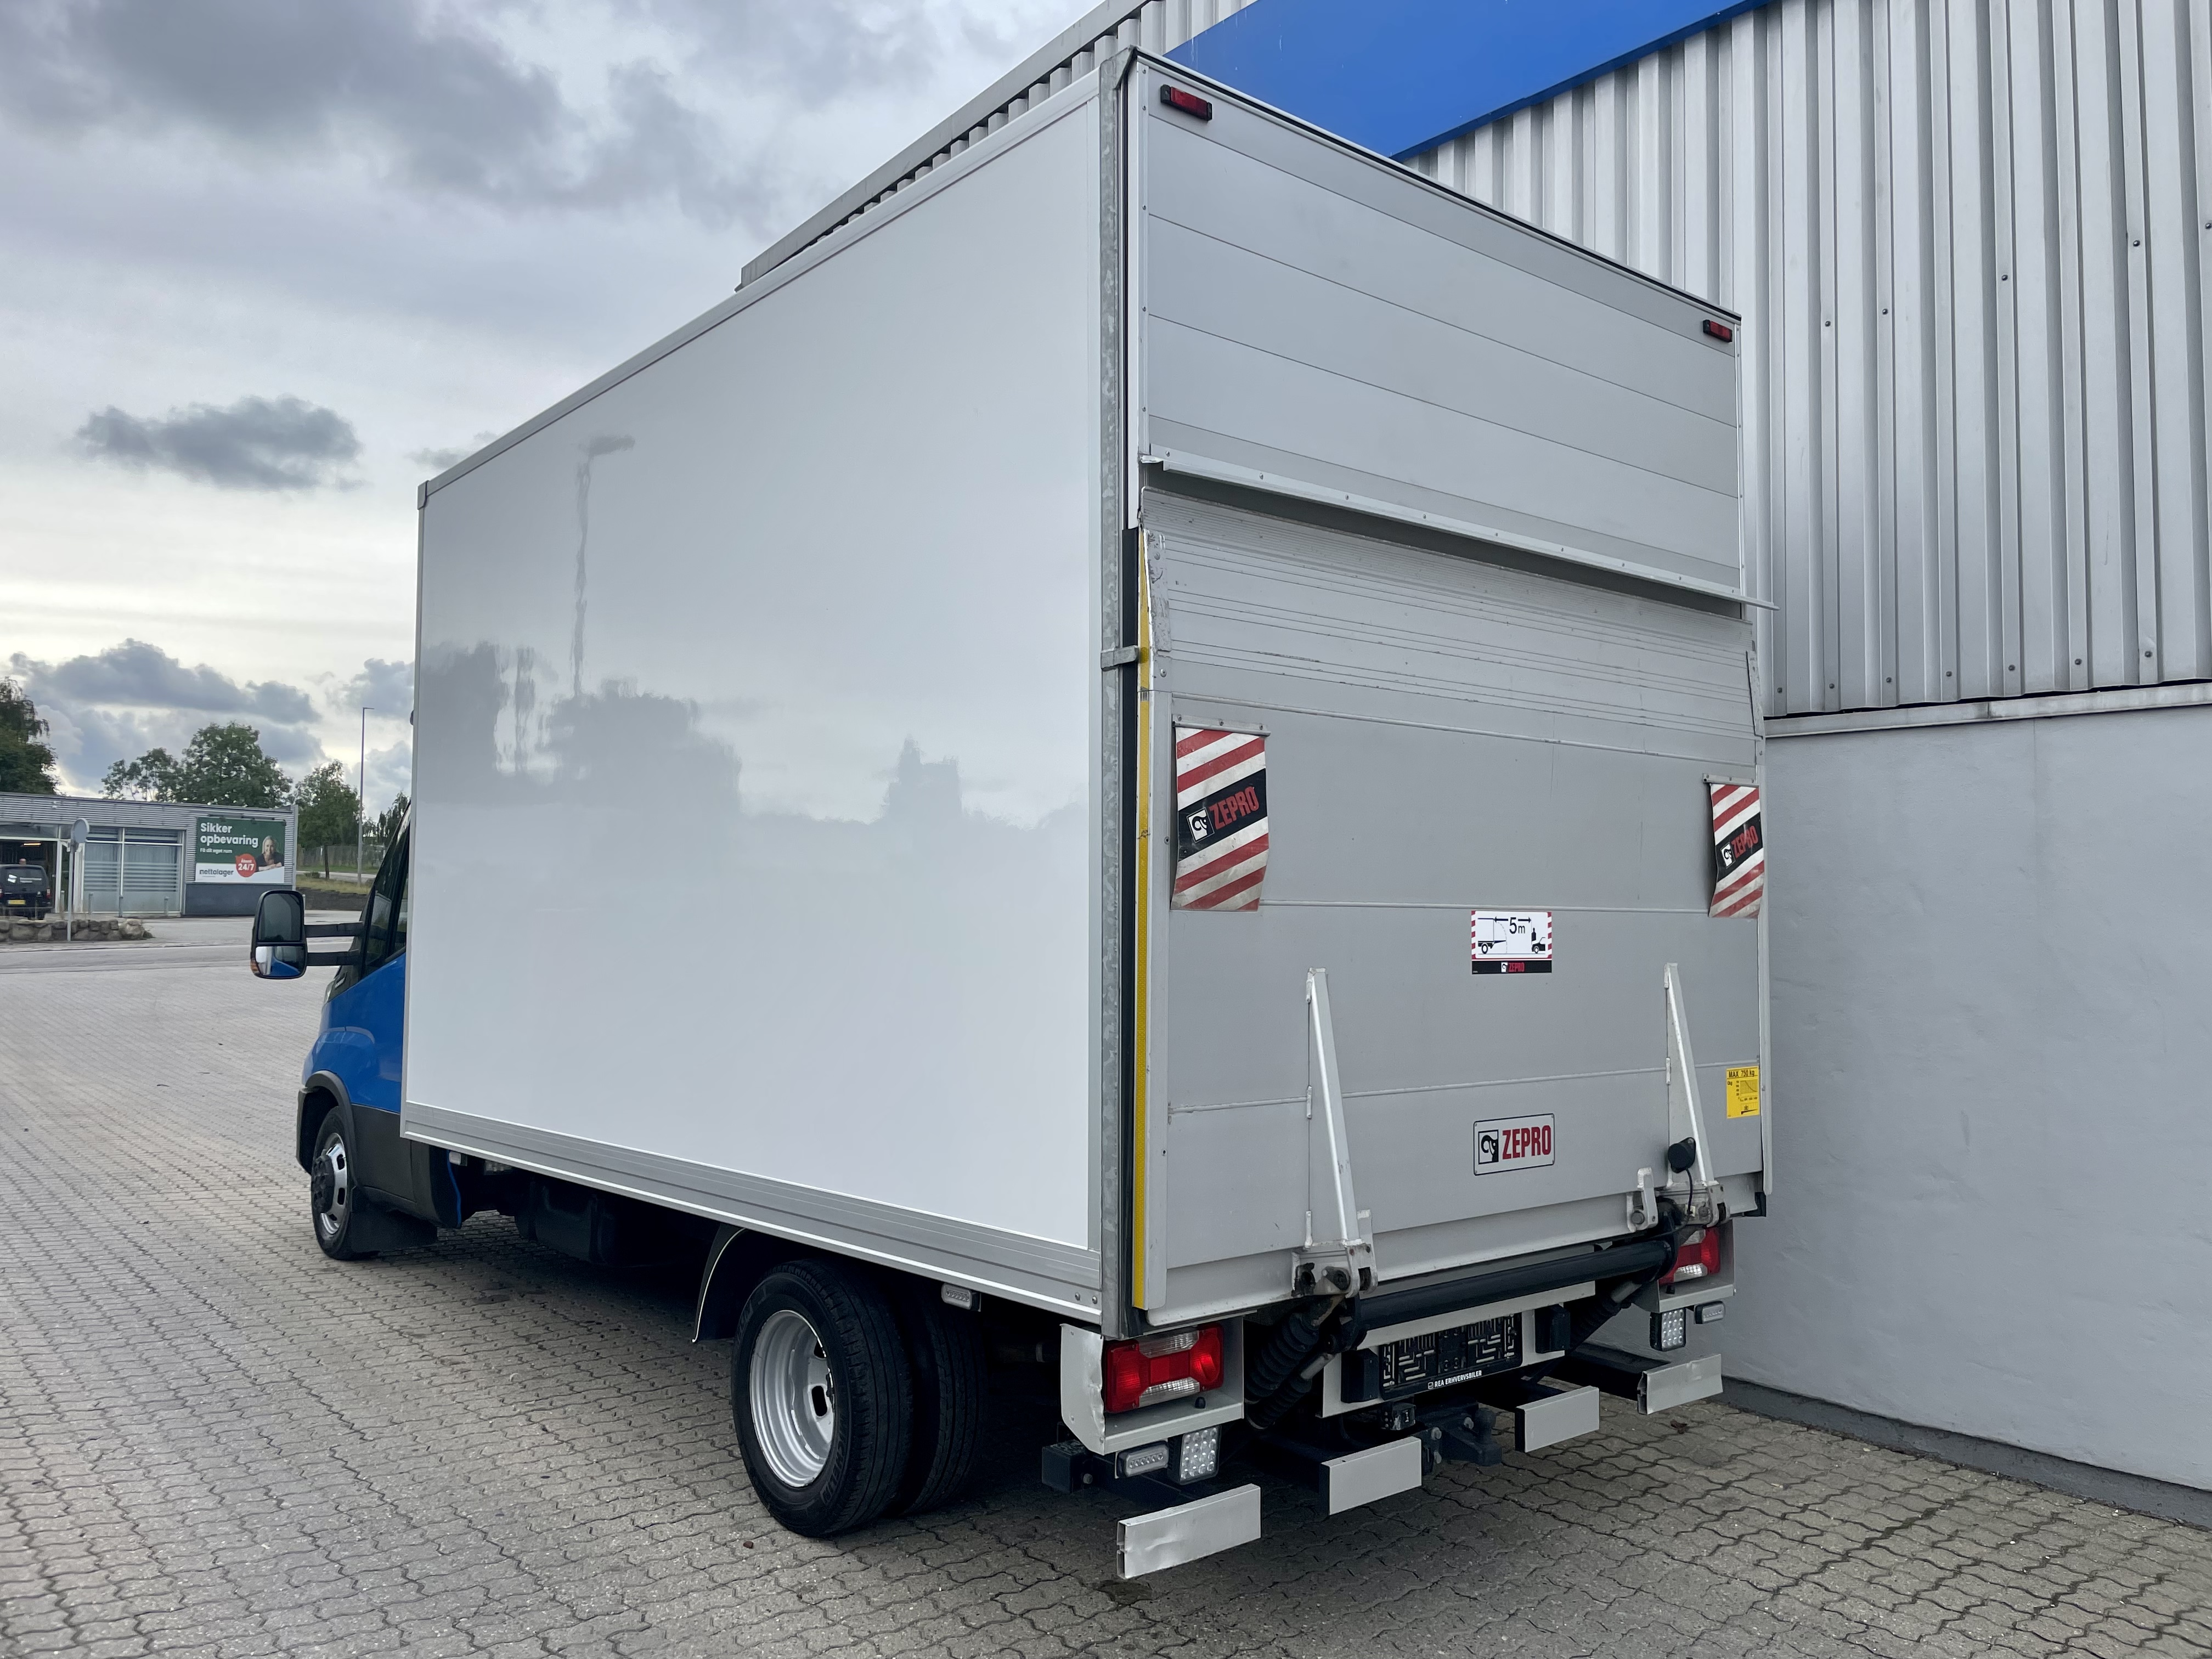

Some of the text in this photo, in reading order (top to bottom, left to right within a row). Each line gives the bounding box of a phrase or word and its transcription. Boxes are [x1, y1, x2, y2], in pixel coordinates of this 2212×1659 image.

[1209, 786, 1260, 830] ZEPRO
[200, 822, 233, 833] Sikker
[200, 834, 258, 848] opbevaring
[1731, 825, 1759, 859] ZEPRO
[199, 868, 234, 877] nettolager
[1508, 962, 1525, 972] ZEPRO
[1502, 1125, 1551, 1160] ZEPRO
[1434, 1370, 1482, 1387] REA ERHVERVSBILER
